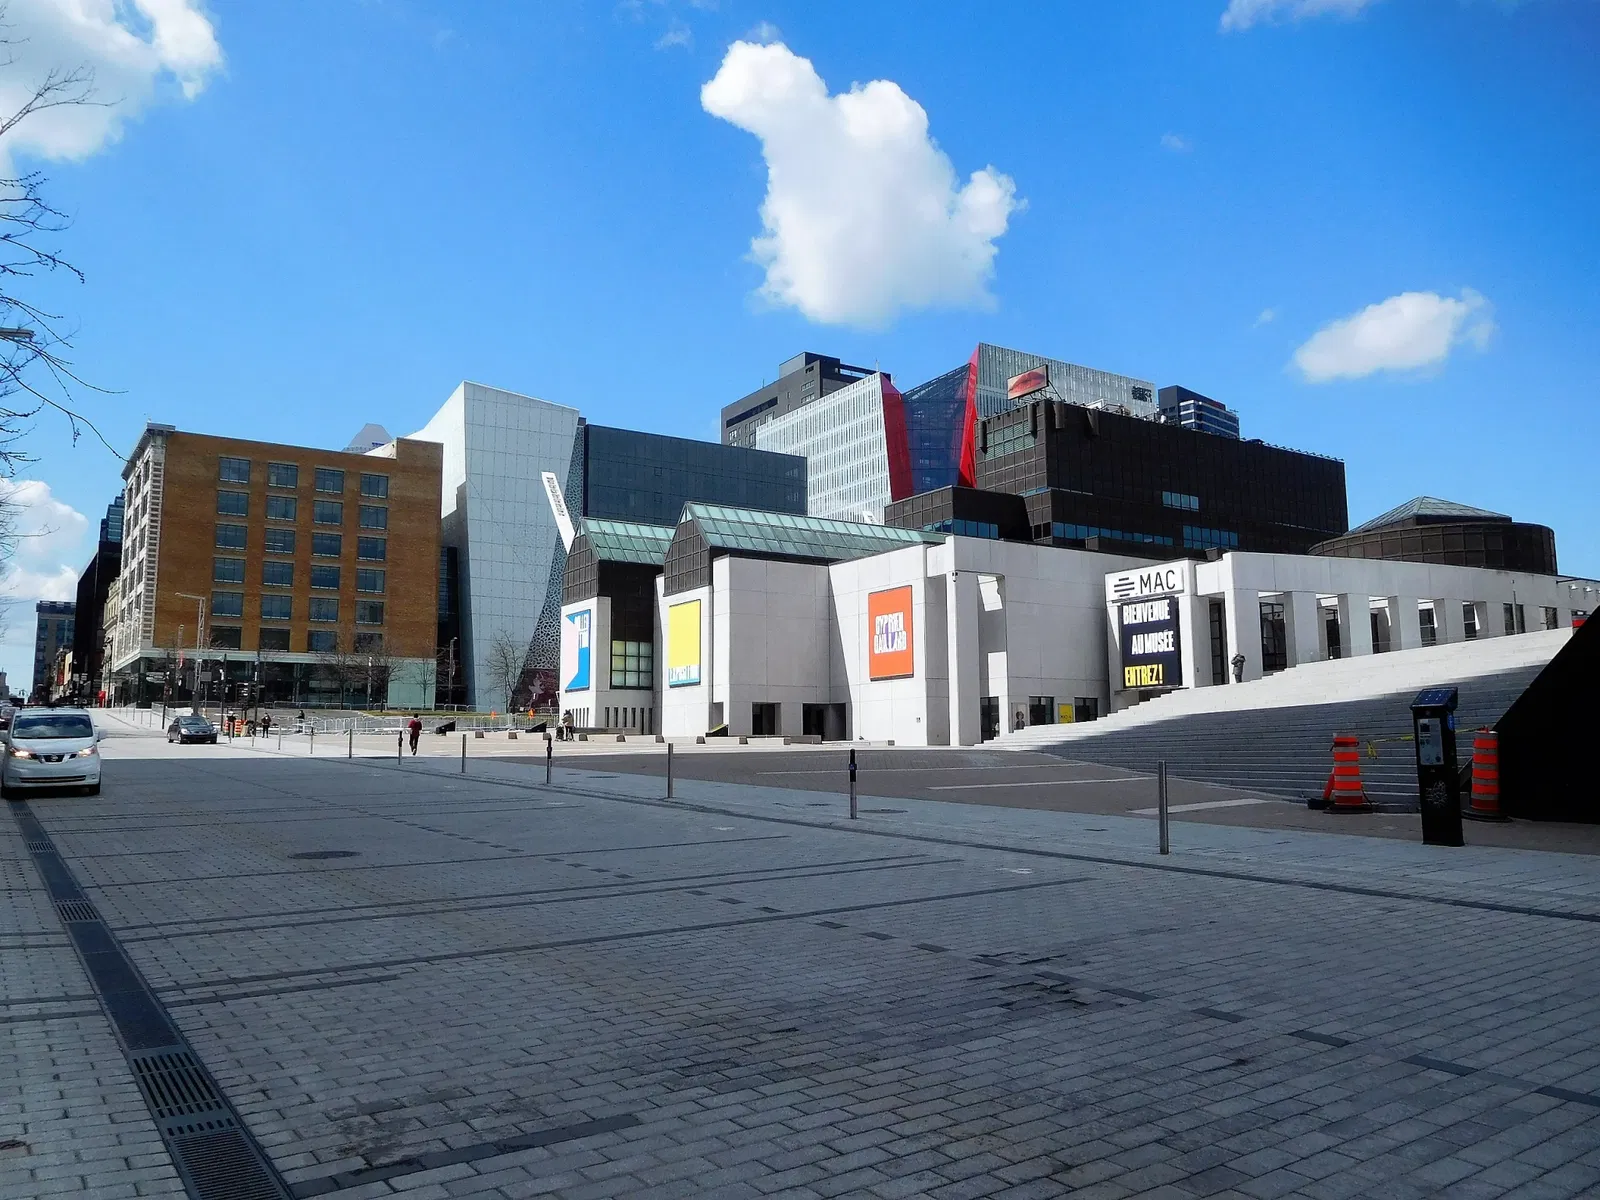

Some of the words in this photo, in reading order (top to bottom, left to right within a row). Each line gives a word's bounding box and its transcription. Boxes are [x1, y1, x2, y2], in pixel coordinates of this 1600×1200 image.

[1139, 569, 1176, 595] MAC
[1122, 599, 1170, 625] BIENVENUE
[1131, 633, 1144, 655] AU
[1144, 629, 1175, 654] MUSÉE
